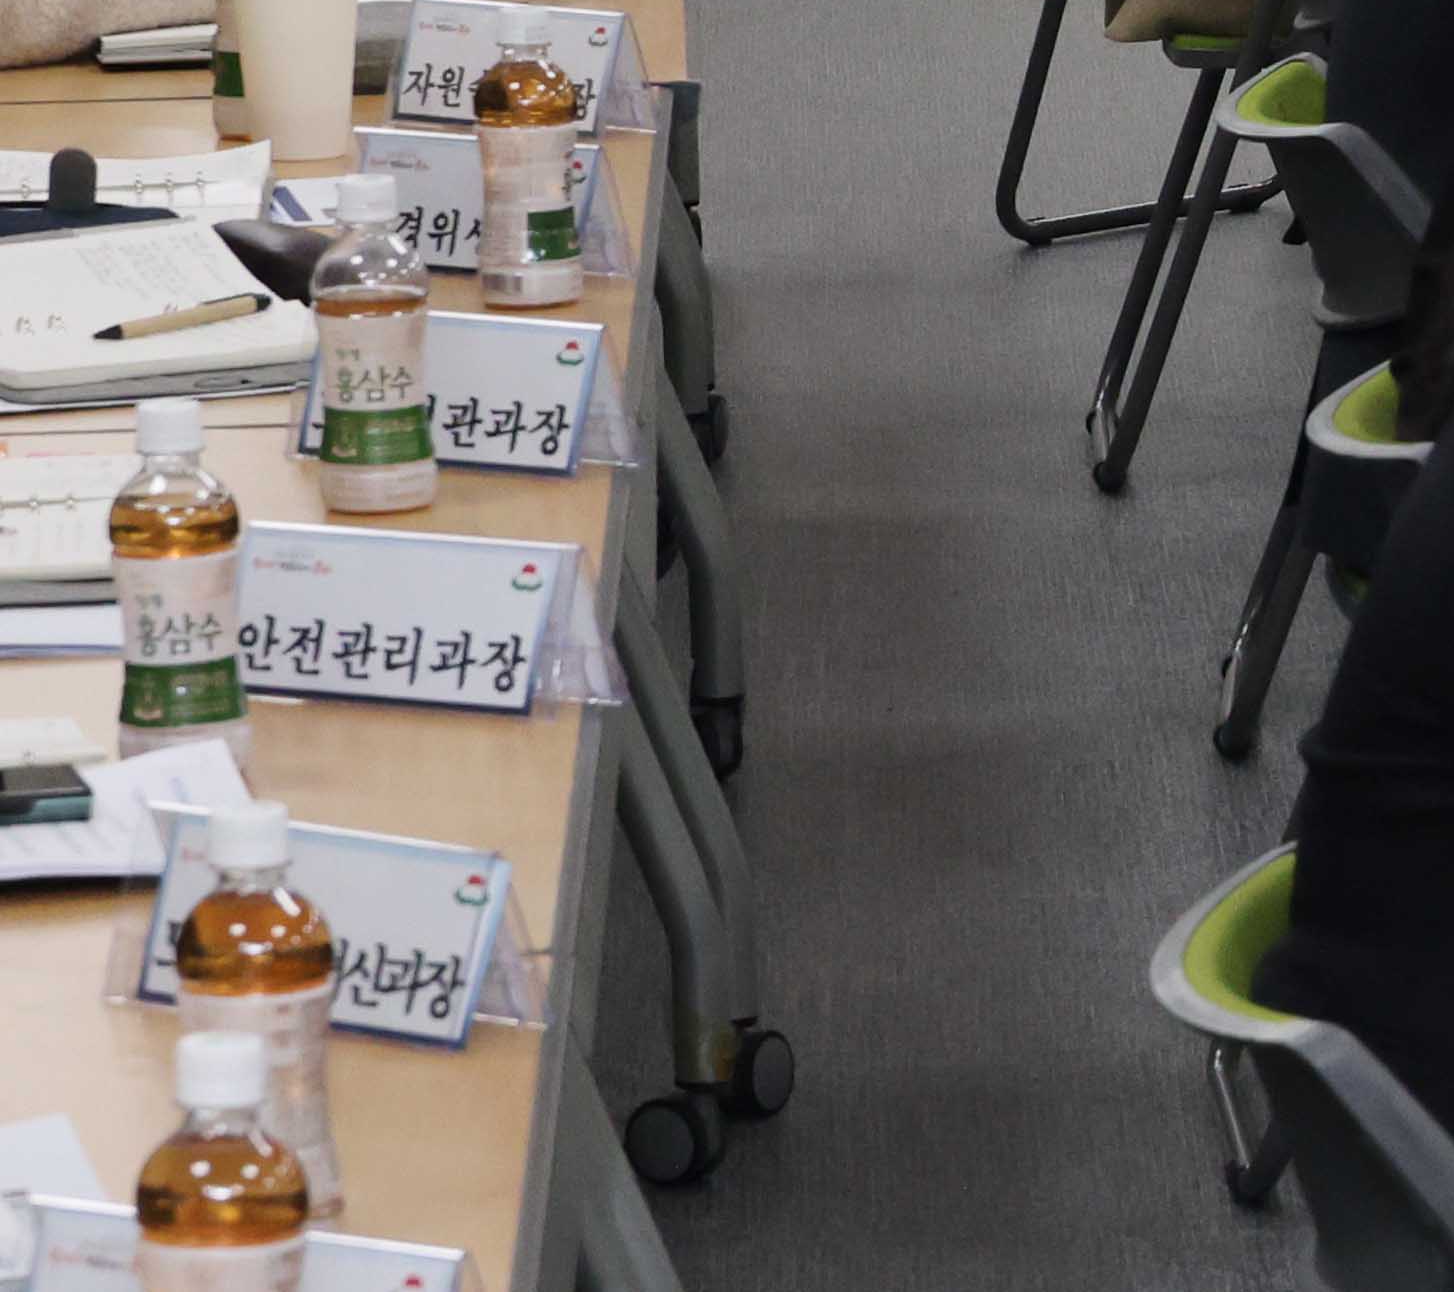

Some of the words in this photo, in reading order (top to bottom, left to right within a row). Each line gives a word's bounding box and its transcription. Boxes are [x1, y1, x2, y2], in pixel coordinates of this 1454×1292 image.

[426, 393, 571, 456] 관과장
[238, 614, 527, 693] 안전관리과장
[335, 937, 466, 1019] 신과장
